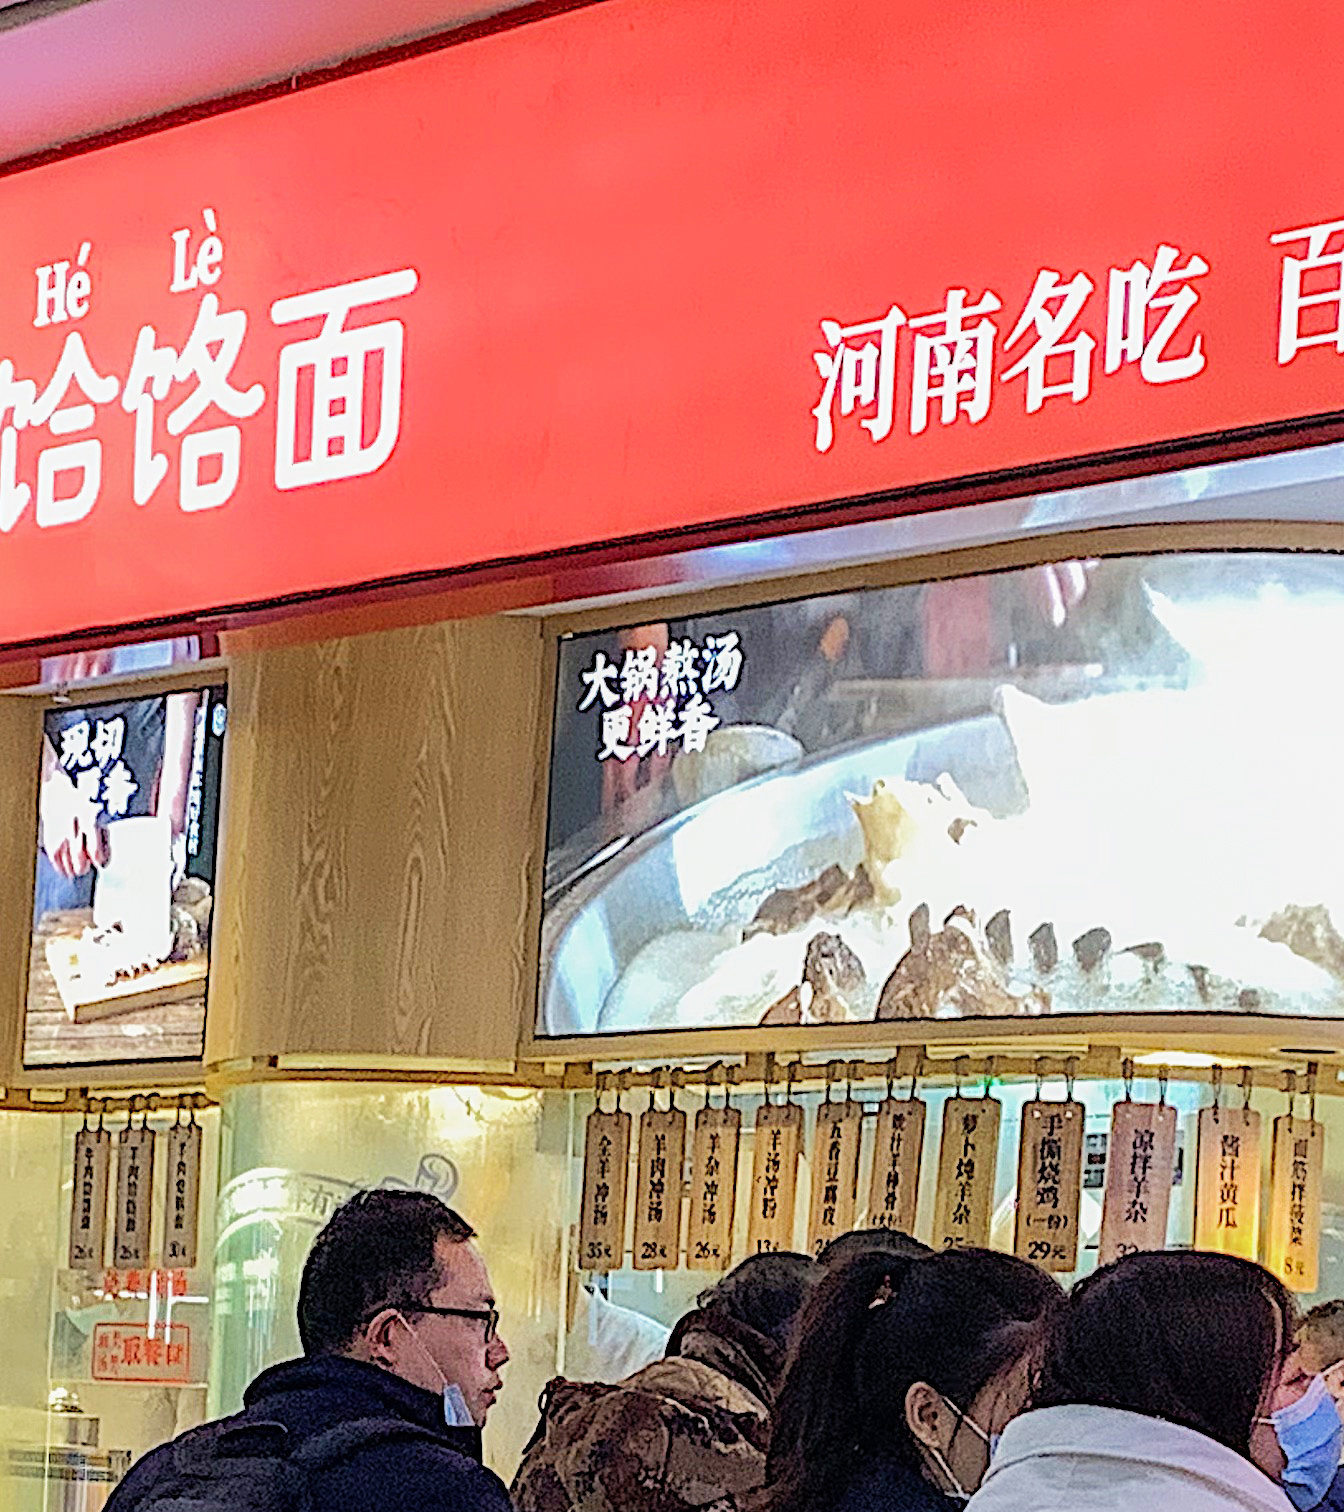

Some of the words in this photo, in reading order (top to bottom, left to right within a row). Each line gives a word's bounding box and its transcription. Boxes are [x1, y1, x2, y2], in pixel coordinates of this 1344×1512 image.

[33, 248, 93, 326] Hé
[169, 208, 224, 297] Lè
[812, 243, 1210, 453] 河南名吃
[578, 631, 743, 711] 大锅熬汤
[598, 693, 719, 761] 更鲜香
